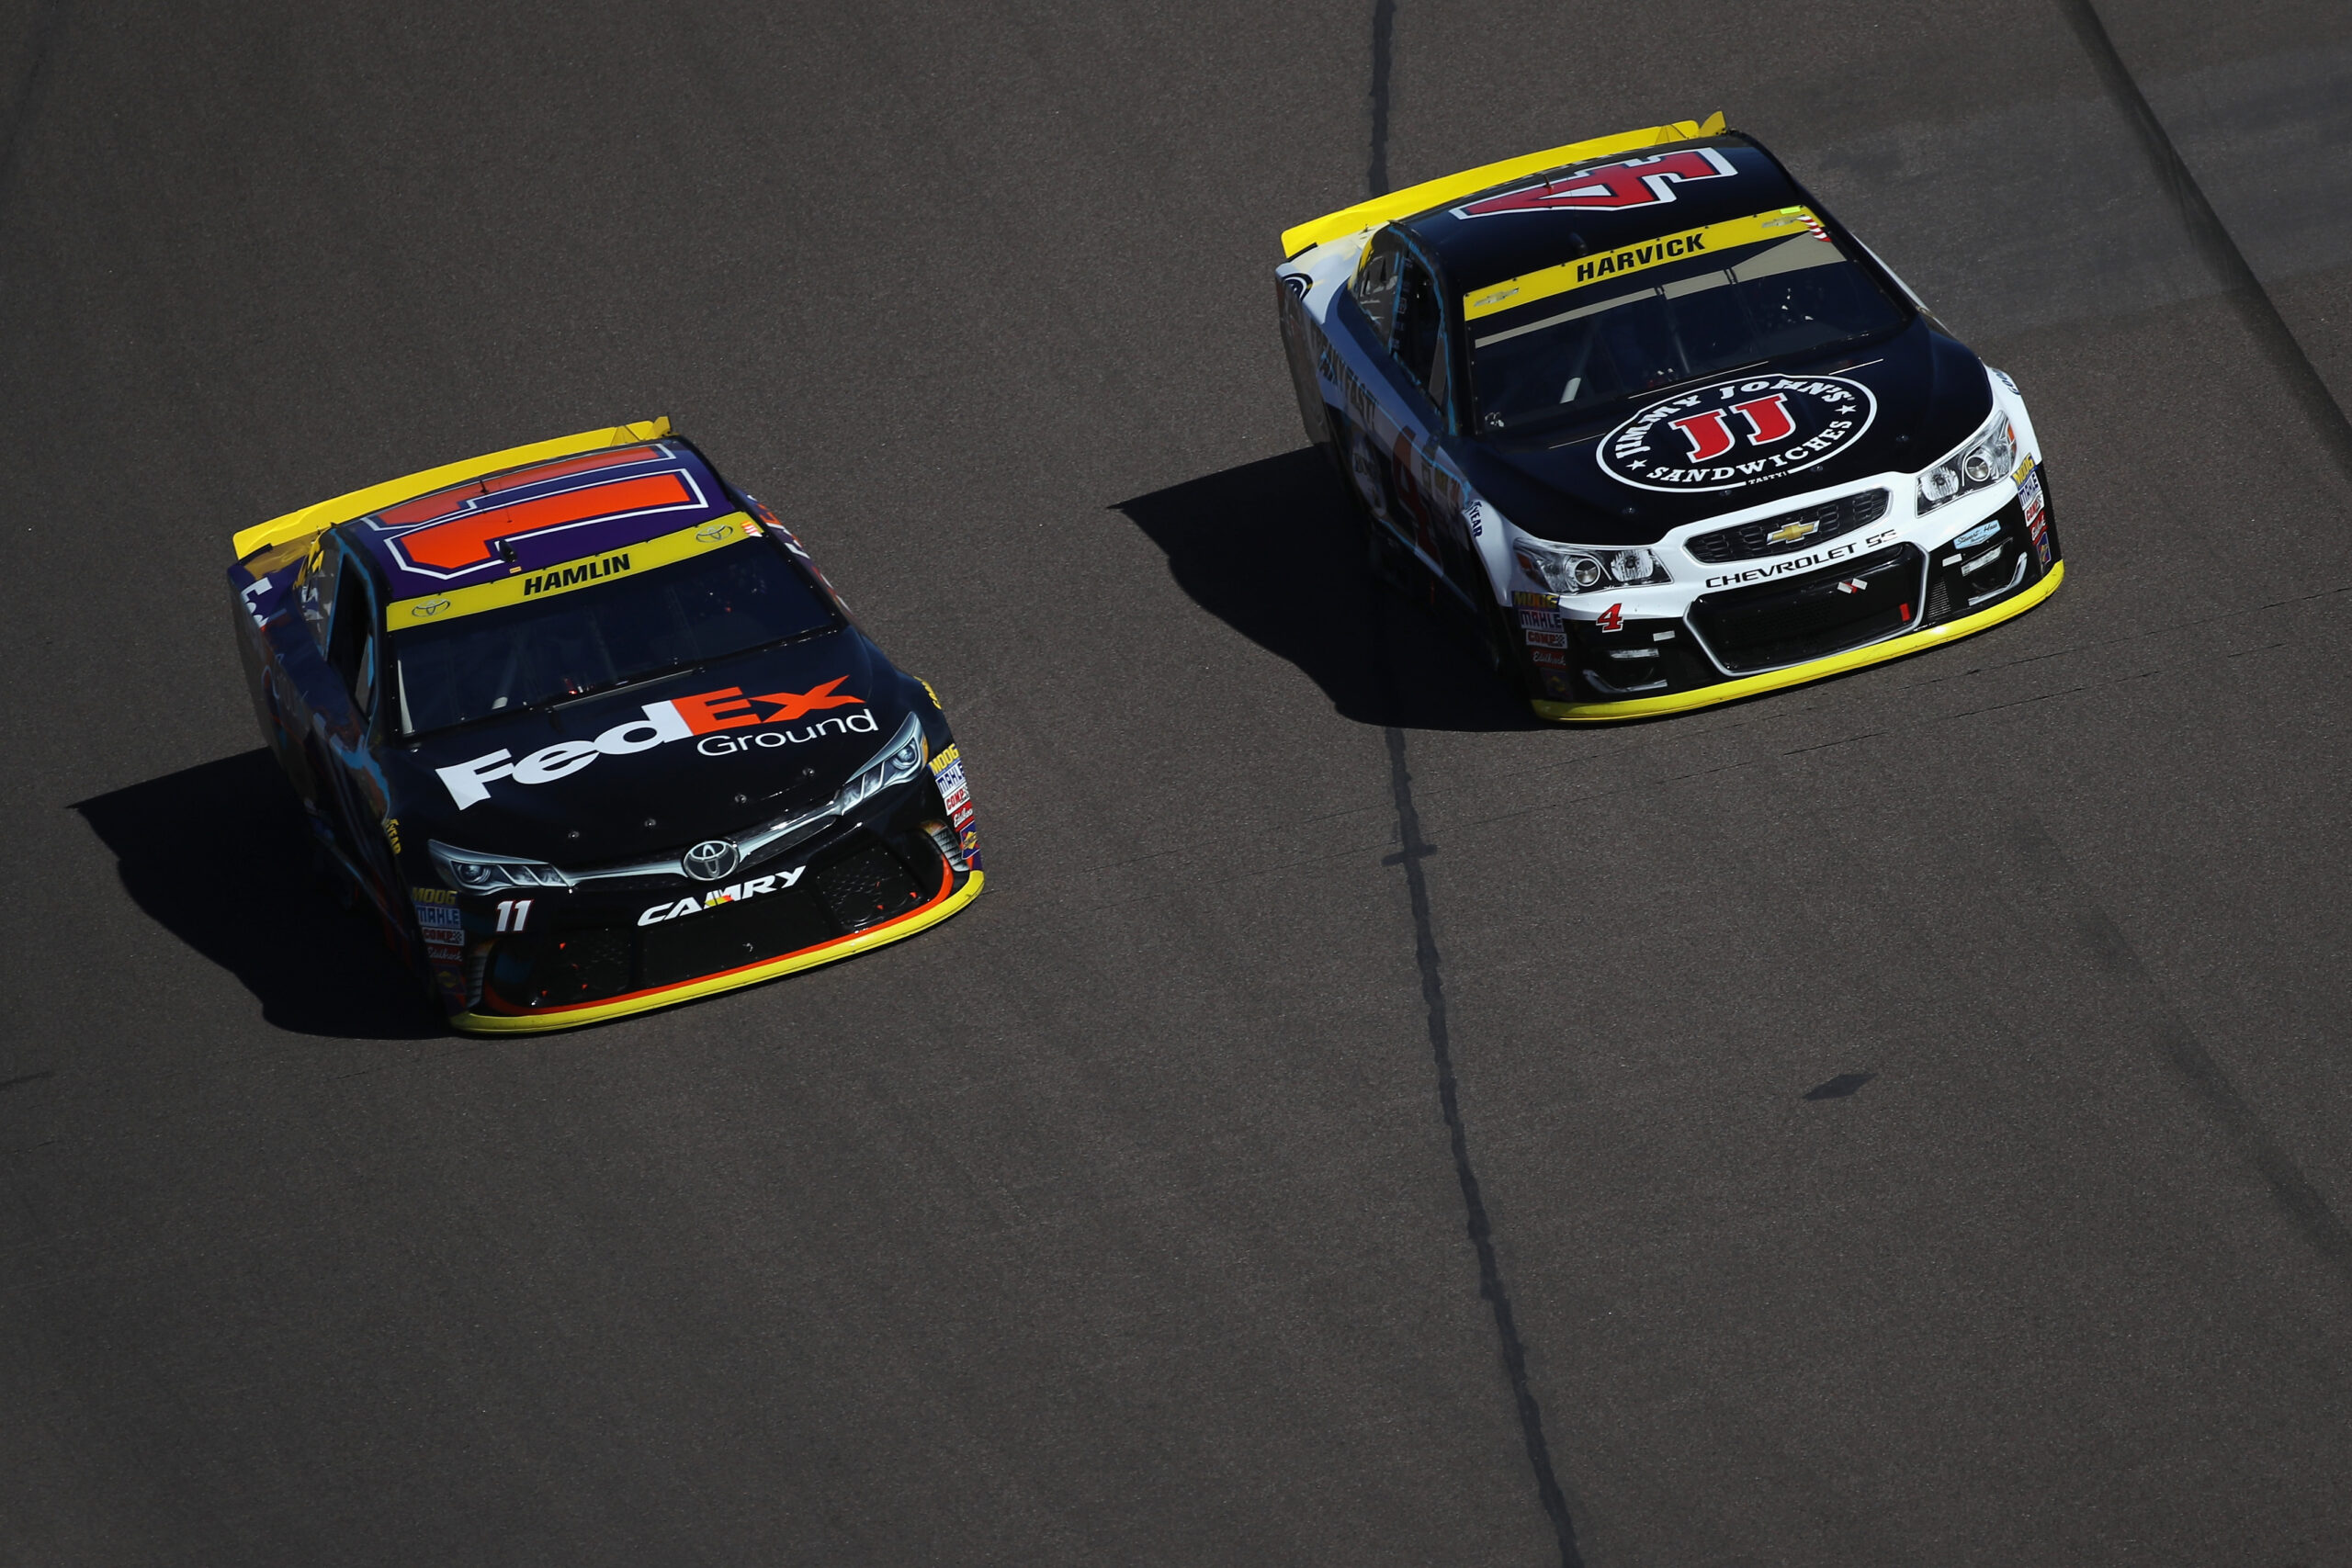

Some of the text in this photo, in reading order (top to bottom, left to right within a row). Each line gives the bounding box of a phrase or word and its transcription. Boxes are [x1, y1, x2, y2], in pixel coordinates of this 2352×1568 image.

[1449, 147, 1738, 220] 4
[1577, 233, 1706, 282] HARVICK
[1615, 379, 1852, 459] JIMMY JOHN'S
[1668, 392, 1796, 463] JJ
[1646, 421, 1852, 483] SANDWICHES
[1748, 471, 1787, 485] TASTY!
[523, 553, 630, 596] HAMLIN
[1706, 529, 1898, 588] CHEVROLET SS
[1521, 610, 1562, 628] MAHLE
[1596, 603, 1624, 634] 4
[435, 675, 865, 810] FedEx
[696, 707, 878, 757] Ground
[929, 743, 960, 776] MOOG
[412, 887, 458, 905] MOOG
[416, 906, 459, 924] MAHLE
[494, 898, 536, 934] 11
[637, 864, 807, 927] CAMRY
